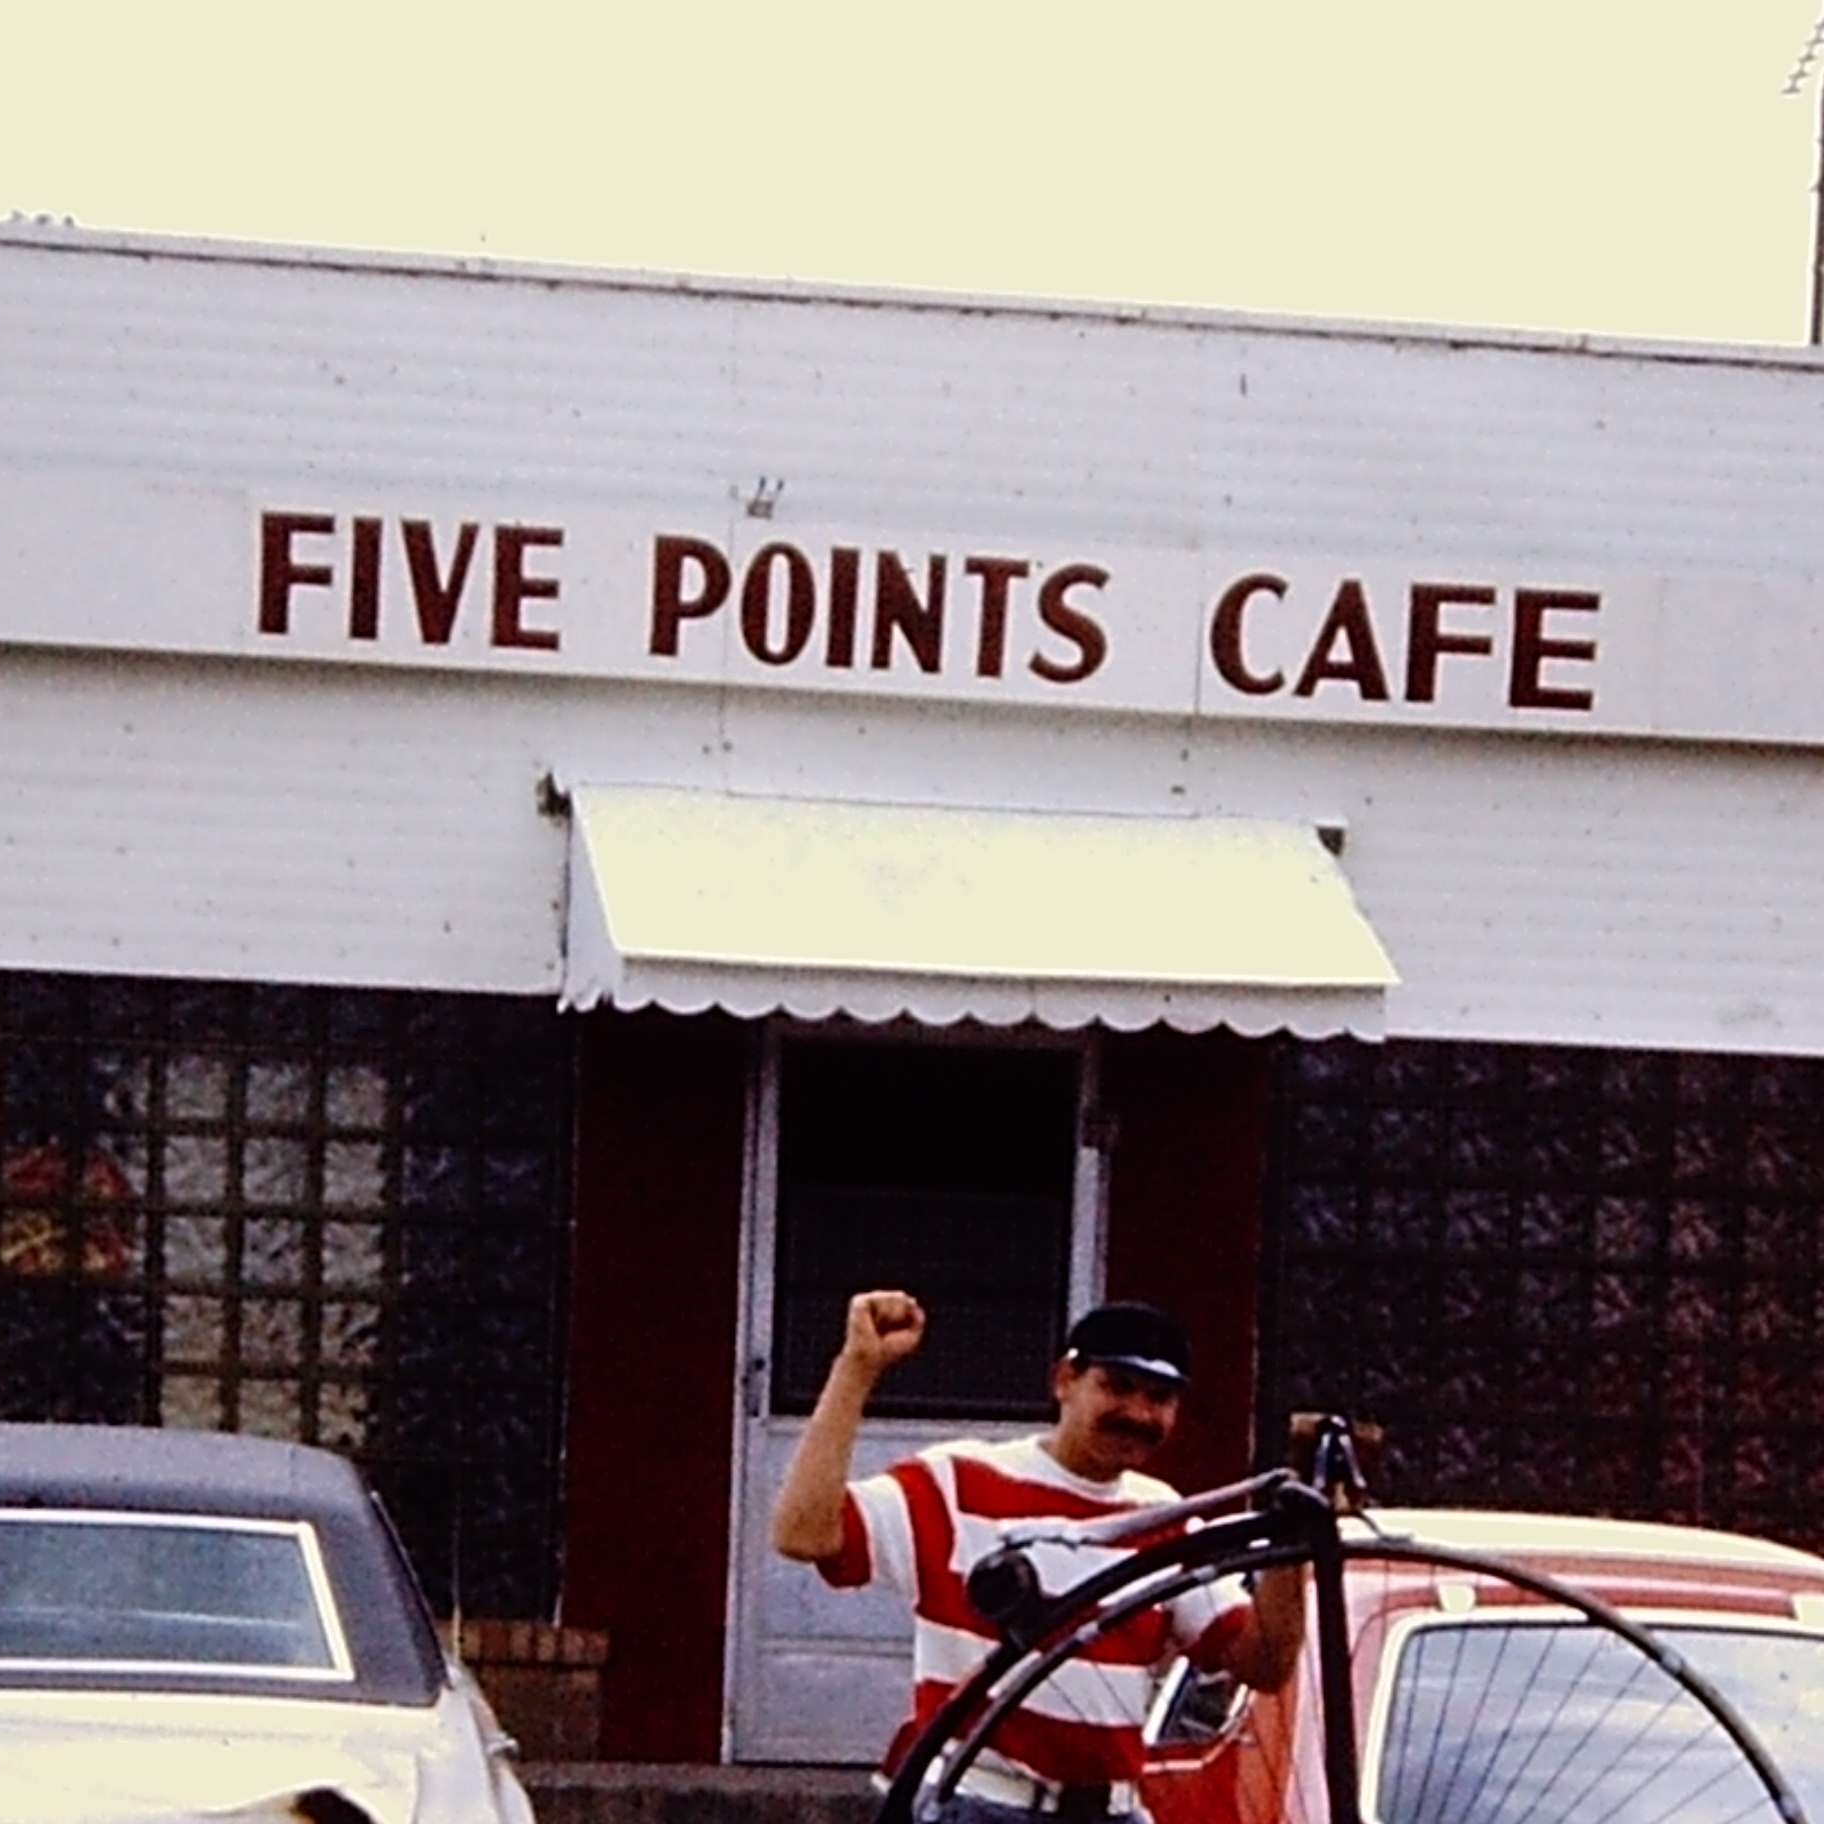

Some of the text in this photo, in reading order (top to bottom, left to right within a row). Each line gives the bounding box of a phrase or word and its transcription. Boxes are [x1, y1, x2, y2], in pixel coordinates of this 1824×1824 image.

[258, 511, 1601, 711] FIVE POINTS CAFE
